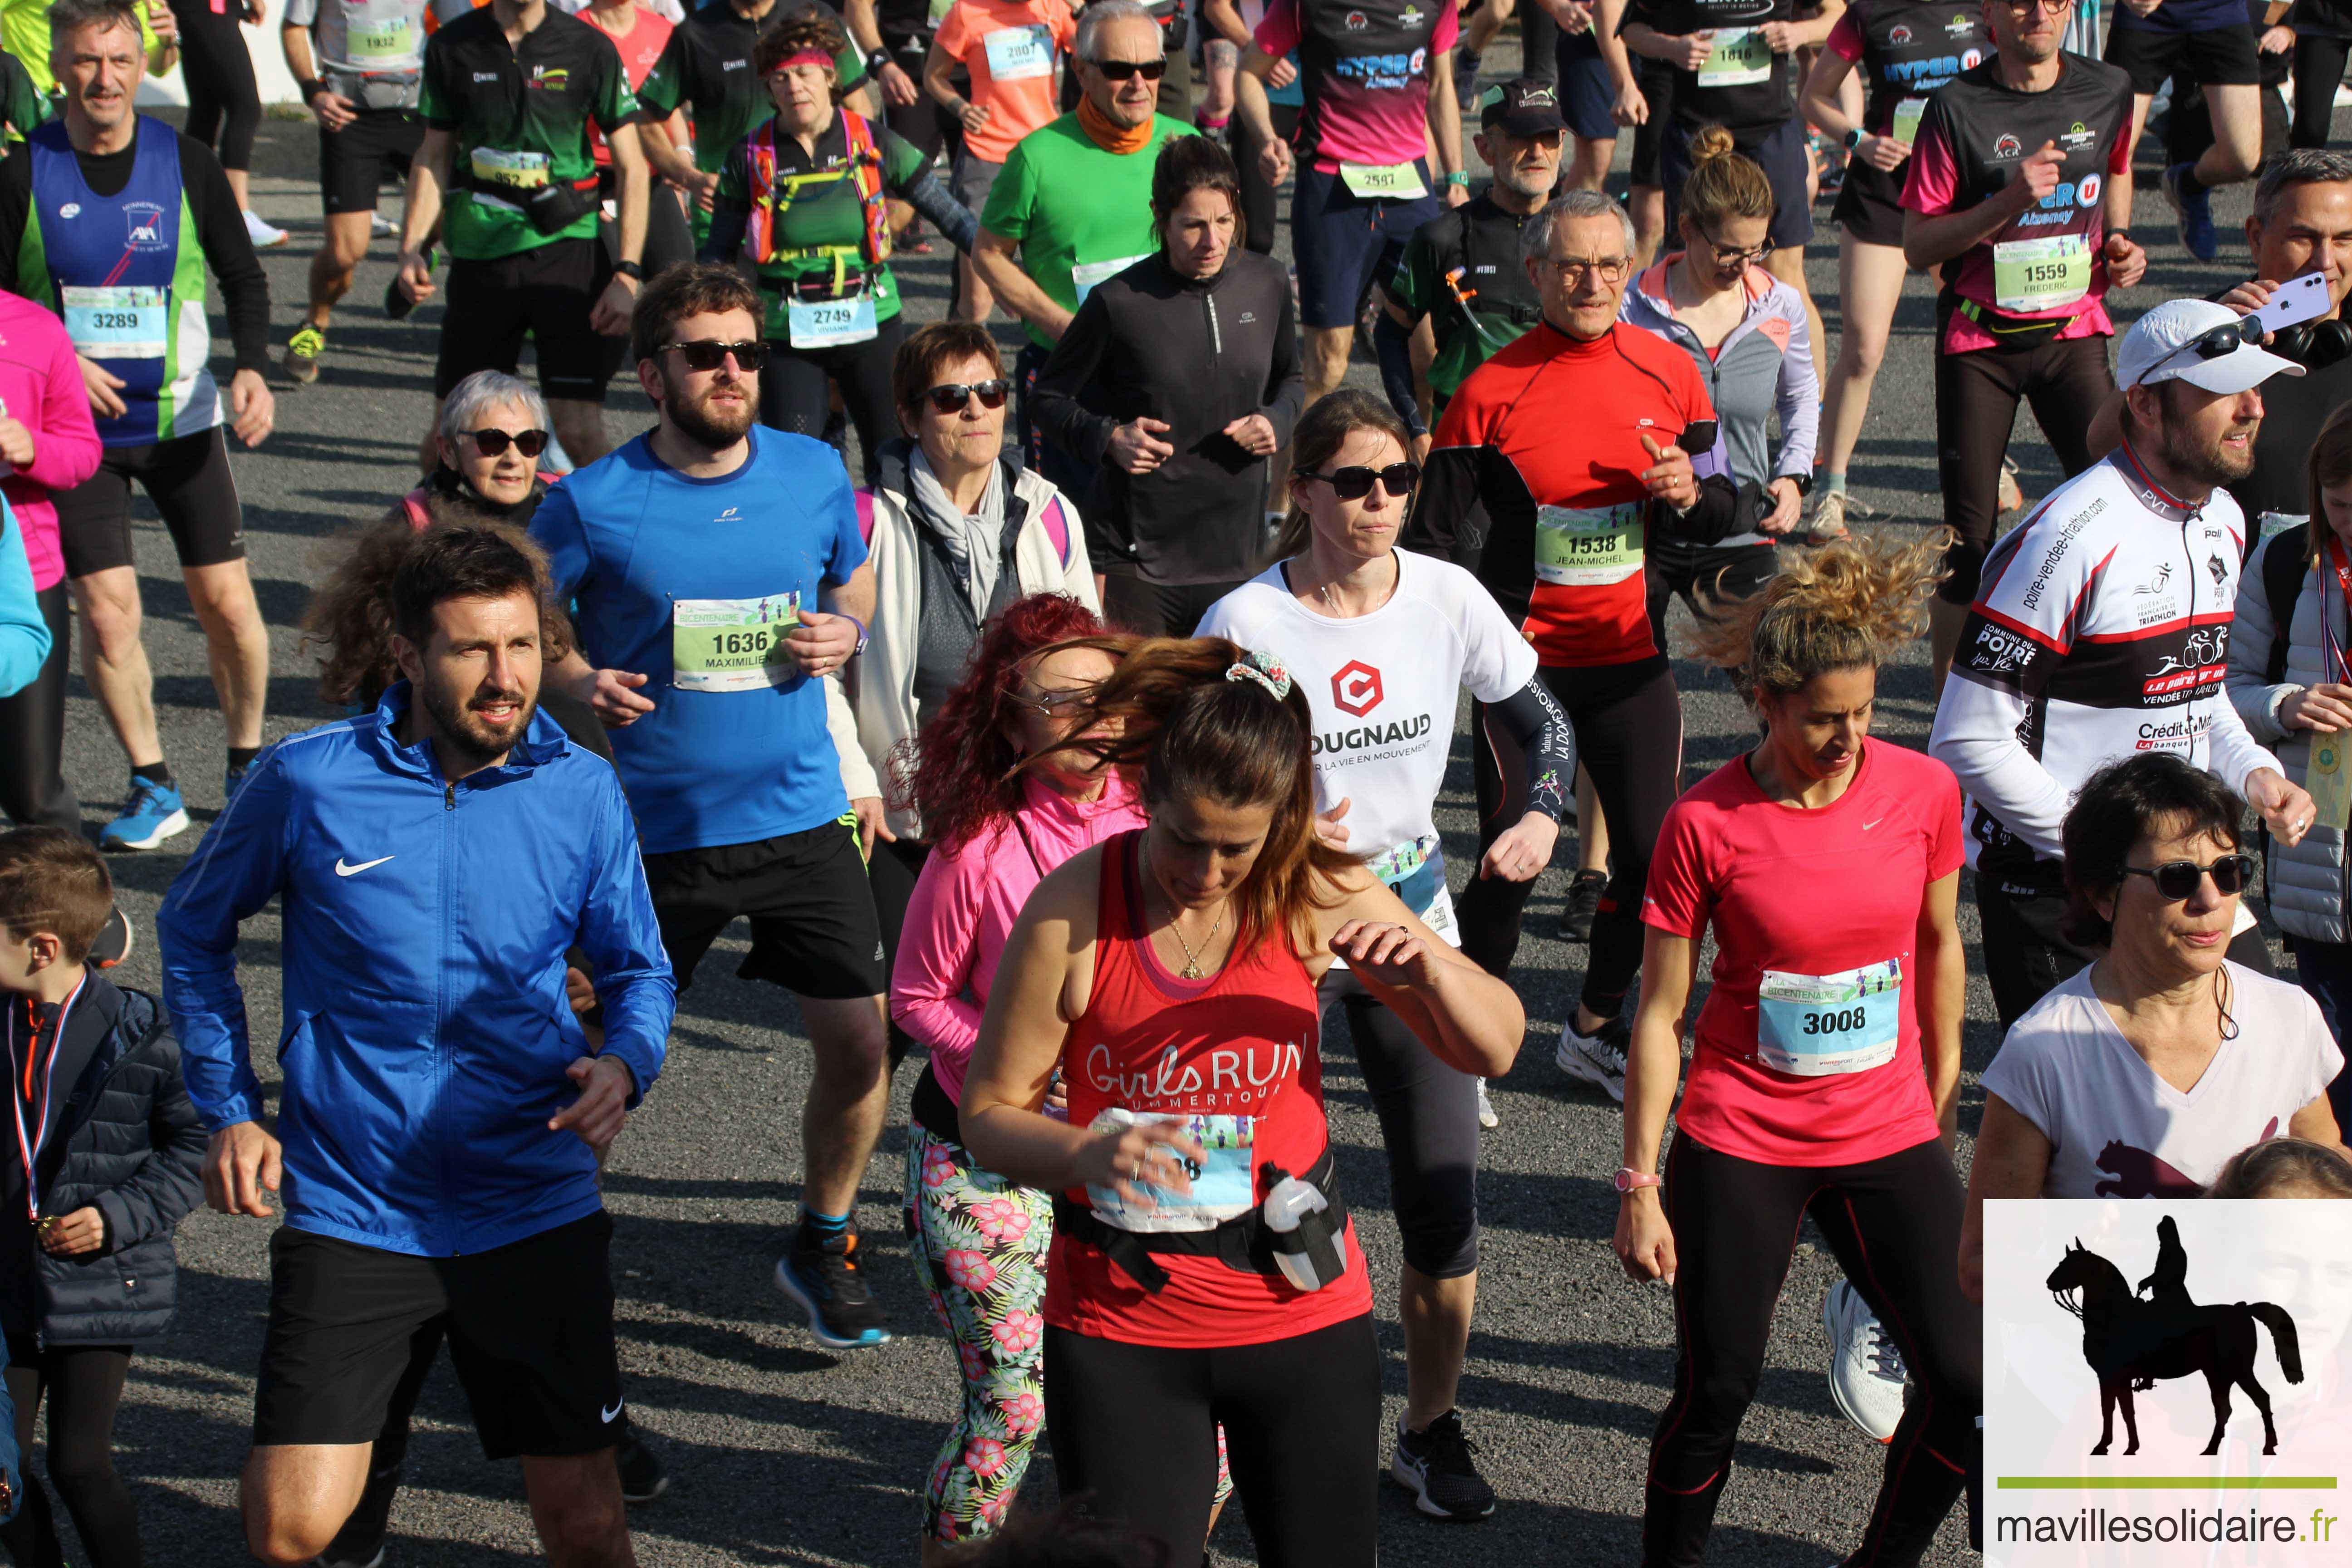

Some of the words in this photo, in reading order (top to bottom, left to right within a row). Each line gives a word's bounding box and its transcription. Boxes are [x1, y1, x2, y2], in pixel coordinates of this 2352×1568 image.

[1884, 55, 1959, 82] HYPER
[1996, 149, 2019, 158] ACR
[129, 226, 157, 240] AXA
[2025, 263, 2067, 282] 1559
[2024, 281, 2068, 293] FREDERIC
[93, 313, 138, 328] 3289
[813, 309, 851, 323] 2749
[2141, 490, 2170, 514] PVT
[2205, 529, 2222, 539] poli
[1569, 534, 1617, 554] 1538
[1556, 554, 1624, 566] JEAN-MICHEL
[2023, 498, 2109, 611] poire-vendee-triathlon.com
[2137, 595, 2175, 612] FÉDÉRATION
[2138, 605, 2168, 617] FRANÇAISE
[679, 613, 739, 622] BICENTENAIRE
[2139, 609, 2176, 626] TRIATHLON
[713, 631, 768, 654] 1636
[1984, 624, 2021, 644] COMMUNE
[2021, 640, 2033, 649] DU
[1975, 630, 2037, 666] POIRÉ
[706, 655, 773, 668] MAXIMILIEN
[1970, 652, 1989, 666] sur
[1992, 653, 2015, 670] Vie
[2143, 691, 2180, 704] VENDÉE
[2138, 721, 2183, 739] Crédit
[2155, 740, 2188, 749] banque
[1325, 761, 1337, 770] LA
[1338, 757, 1354, 767] VIE
[1357, 754, 1371, 763] EN
[1374, 740, 1431, 761] MOUVEMENT
[1555, 747, 1569, 760] LA
[1768, 987, 1836, 1000] BICENTENAIRE
[1803, 1006, 1866, 1035] 3008
[1087, 1044, 1202, 1099] Girls
[1212, 1032, 1307, 1089] RUN
